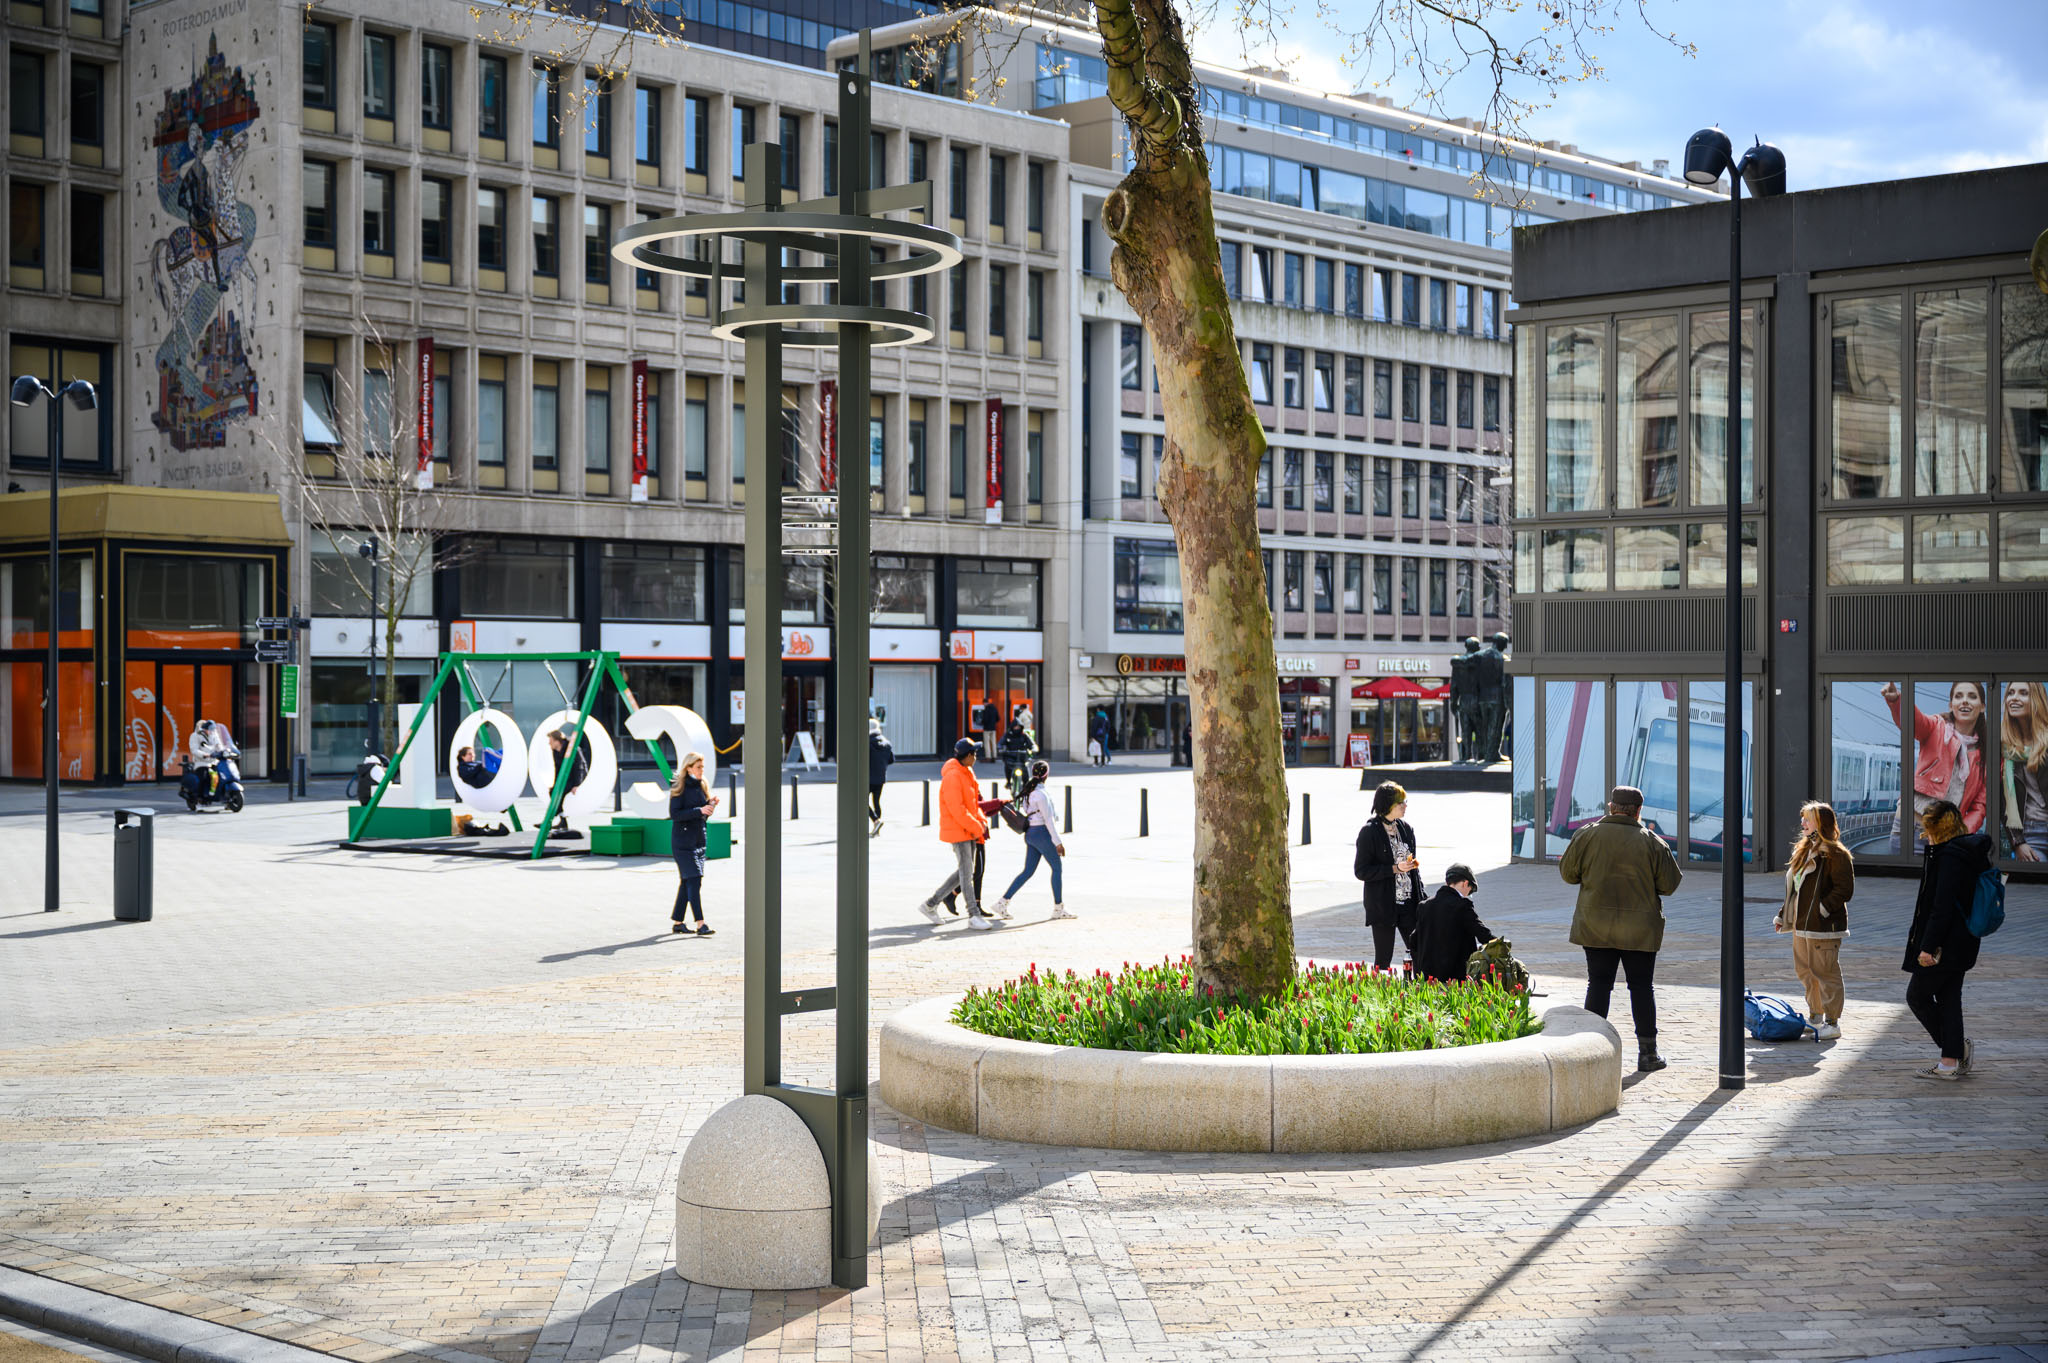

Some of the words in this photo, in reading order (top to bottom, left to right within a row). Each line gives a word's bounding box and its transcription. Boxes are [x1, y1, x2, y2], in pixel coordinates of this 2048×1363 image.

[162, 0, 247, 38] ROTERODAMUM
[422, 353, 430, 382] Open
[636, 374, 644, 401] Open
[422, 384, 430, 441] Universiteit
[990, 411, 998, 434] Open
[636, 402, 644, 456] Universiteit
[206, 461, 244, 478] BASILEA
[1285, 658, 1316, 671] GUYS
[1378, 659, 1402, 671] FIVE
[1404, 659, 1431, 671] GUYS
